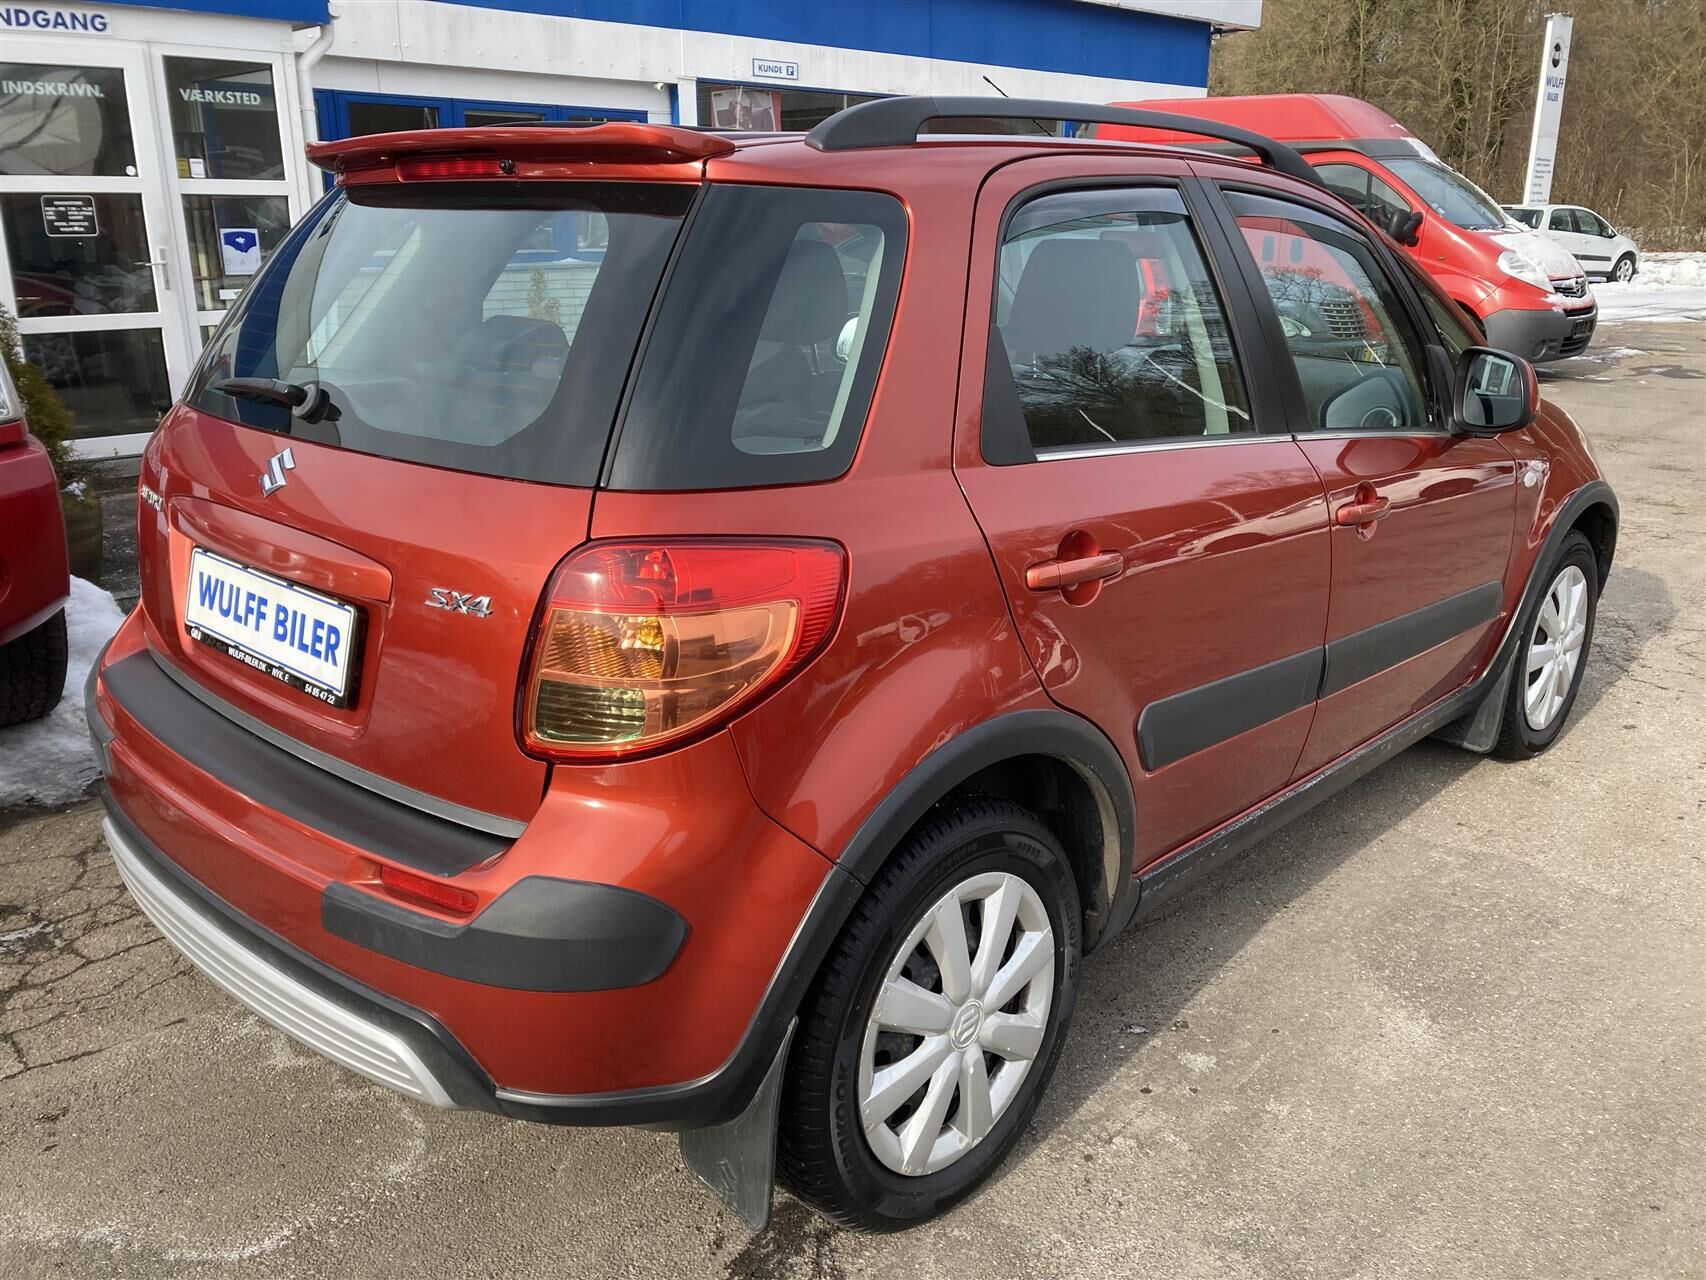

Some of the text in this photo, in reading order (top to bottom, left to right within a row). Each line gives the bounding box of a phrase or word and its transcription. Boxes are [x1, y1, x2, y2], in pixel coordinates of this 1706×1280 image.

[758, 63, 782, 74] KUNDE
[2, 80, 105, 97] INDSKRIVN.
[1546, 75, 1565, 88] WULFF
[179, 87, 261, 105] VÆRKSTED
[1547, 92, 1559, 102] BILER
[424, 587, 494, 618] SX4
[199, 571, 341, 668] WULFF BILER
[304, 683, 313, 694] 54
[320, 691, 328, 701] 47
[326, 694, 336, 705] 22
